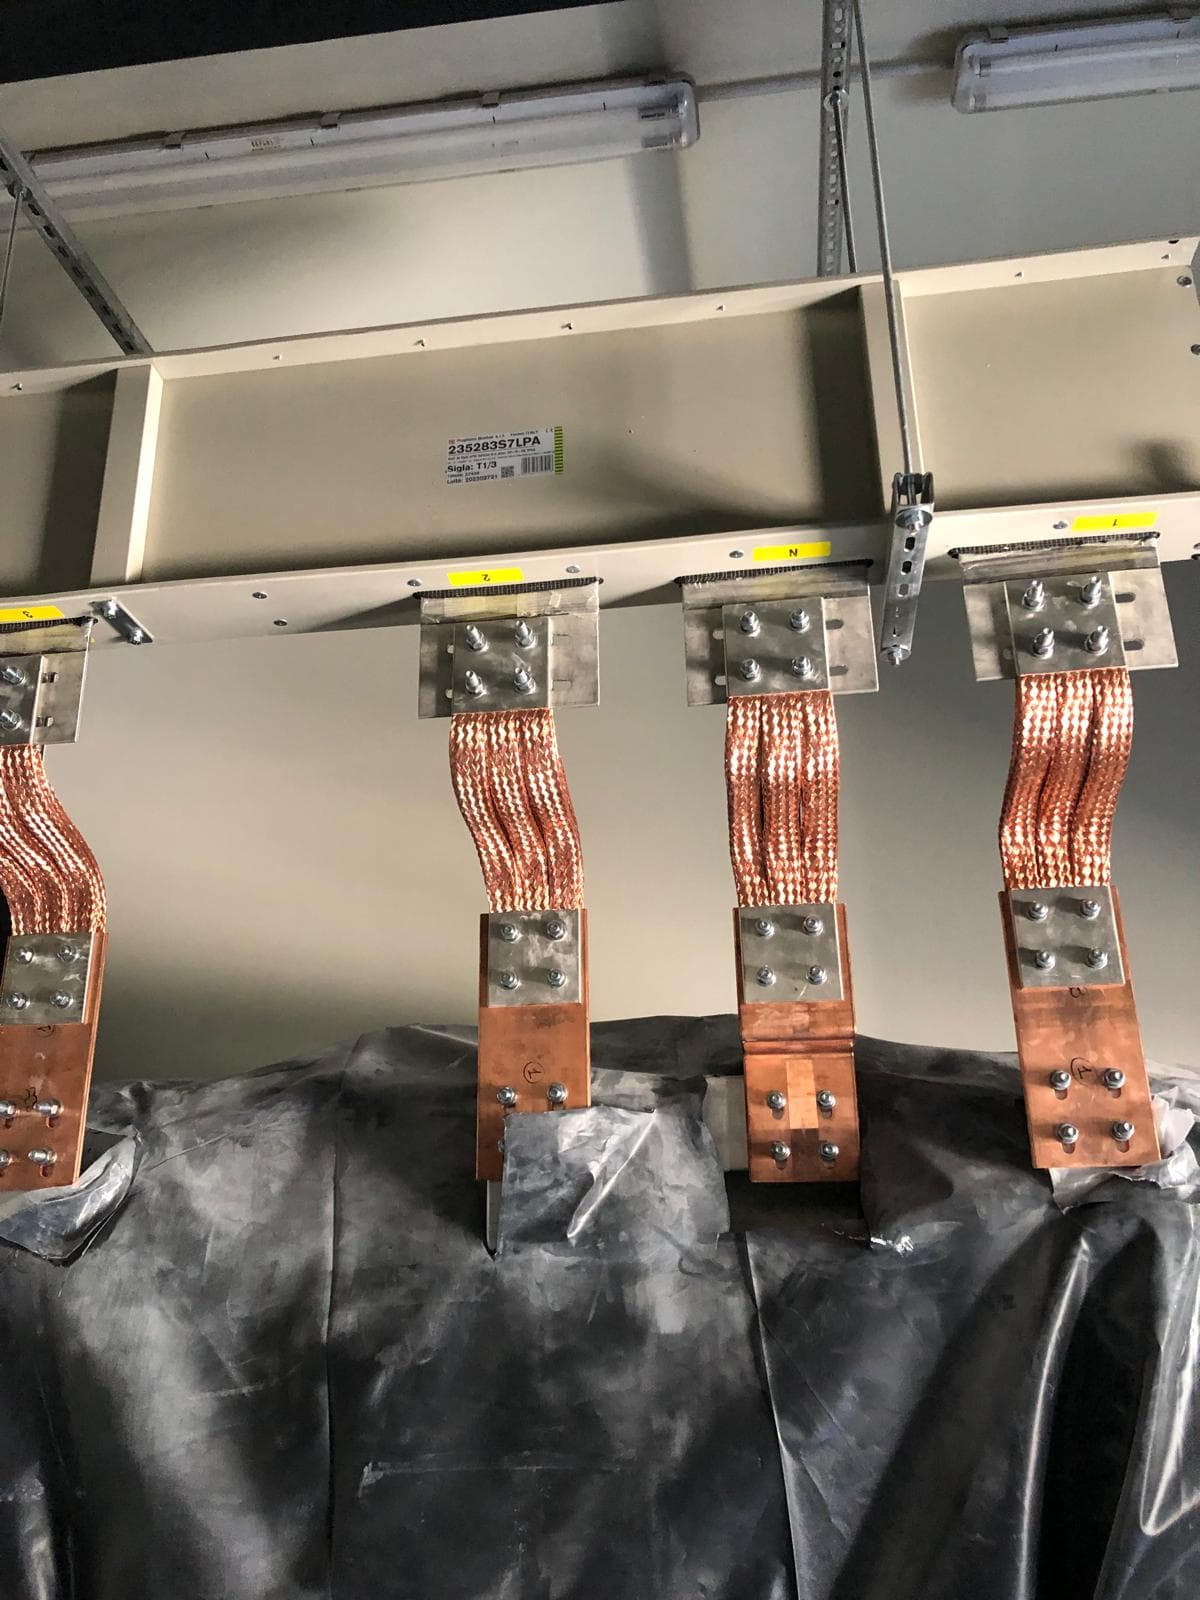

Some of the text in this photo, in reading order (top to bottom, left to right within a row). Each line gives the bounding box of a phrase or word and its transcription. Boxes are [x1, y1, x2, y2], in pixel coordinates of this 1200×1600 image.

[448, 435, 541, 455] 235283S7LPA
[447, 460, 497, 472] Sigla: T1/3
[788, 548, 798, 557] N
